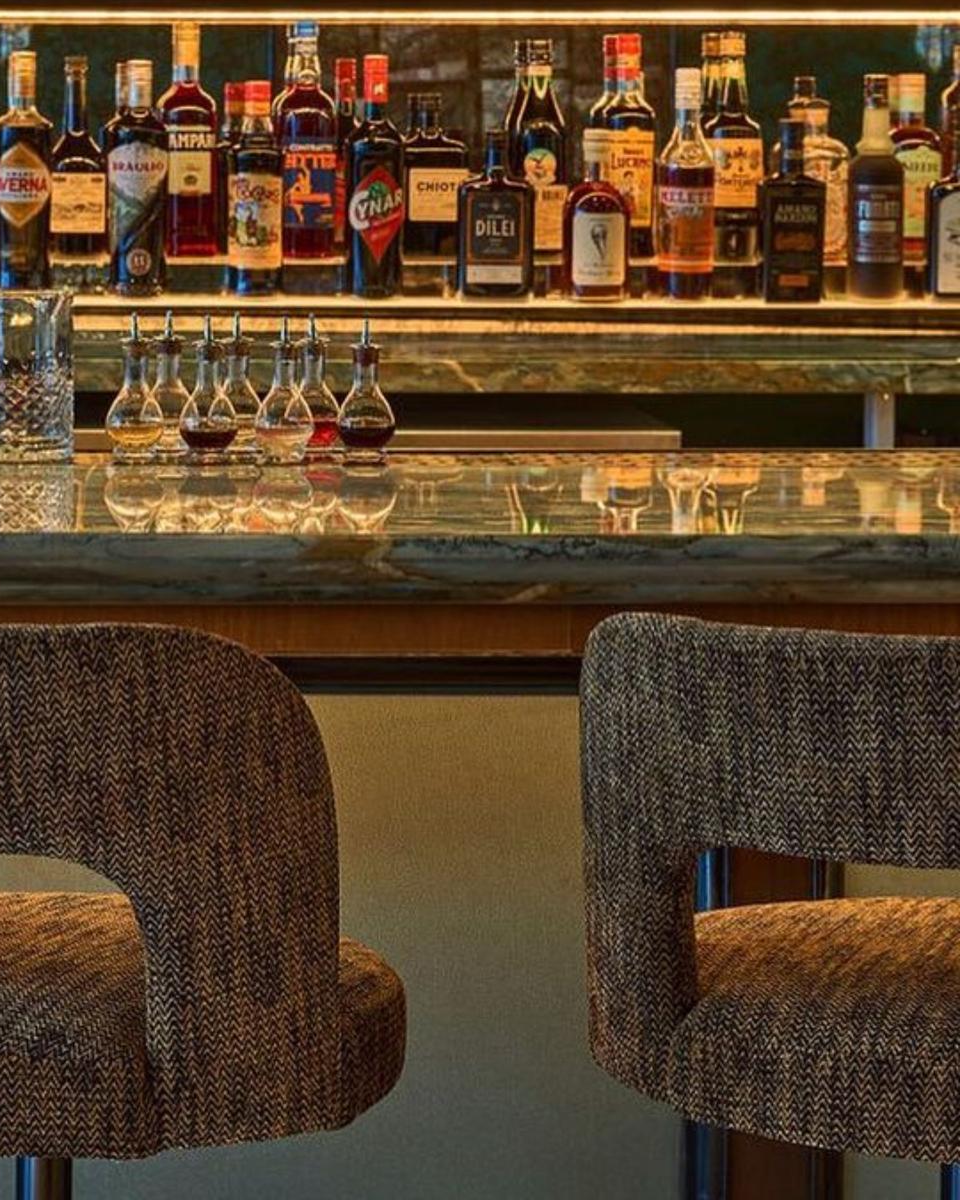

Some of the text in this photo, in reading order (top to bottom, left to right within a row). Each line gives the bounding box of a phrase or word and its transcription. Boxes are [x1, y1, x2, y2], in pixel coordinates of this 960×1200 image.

[168, 133, 216, 148] AMPARI
[112, 159, 164, 171] BRAULIO
[348, 187, 403, 231] CYNAR
[475, 220, 516, 237] DILEI
